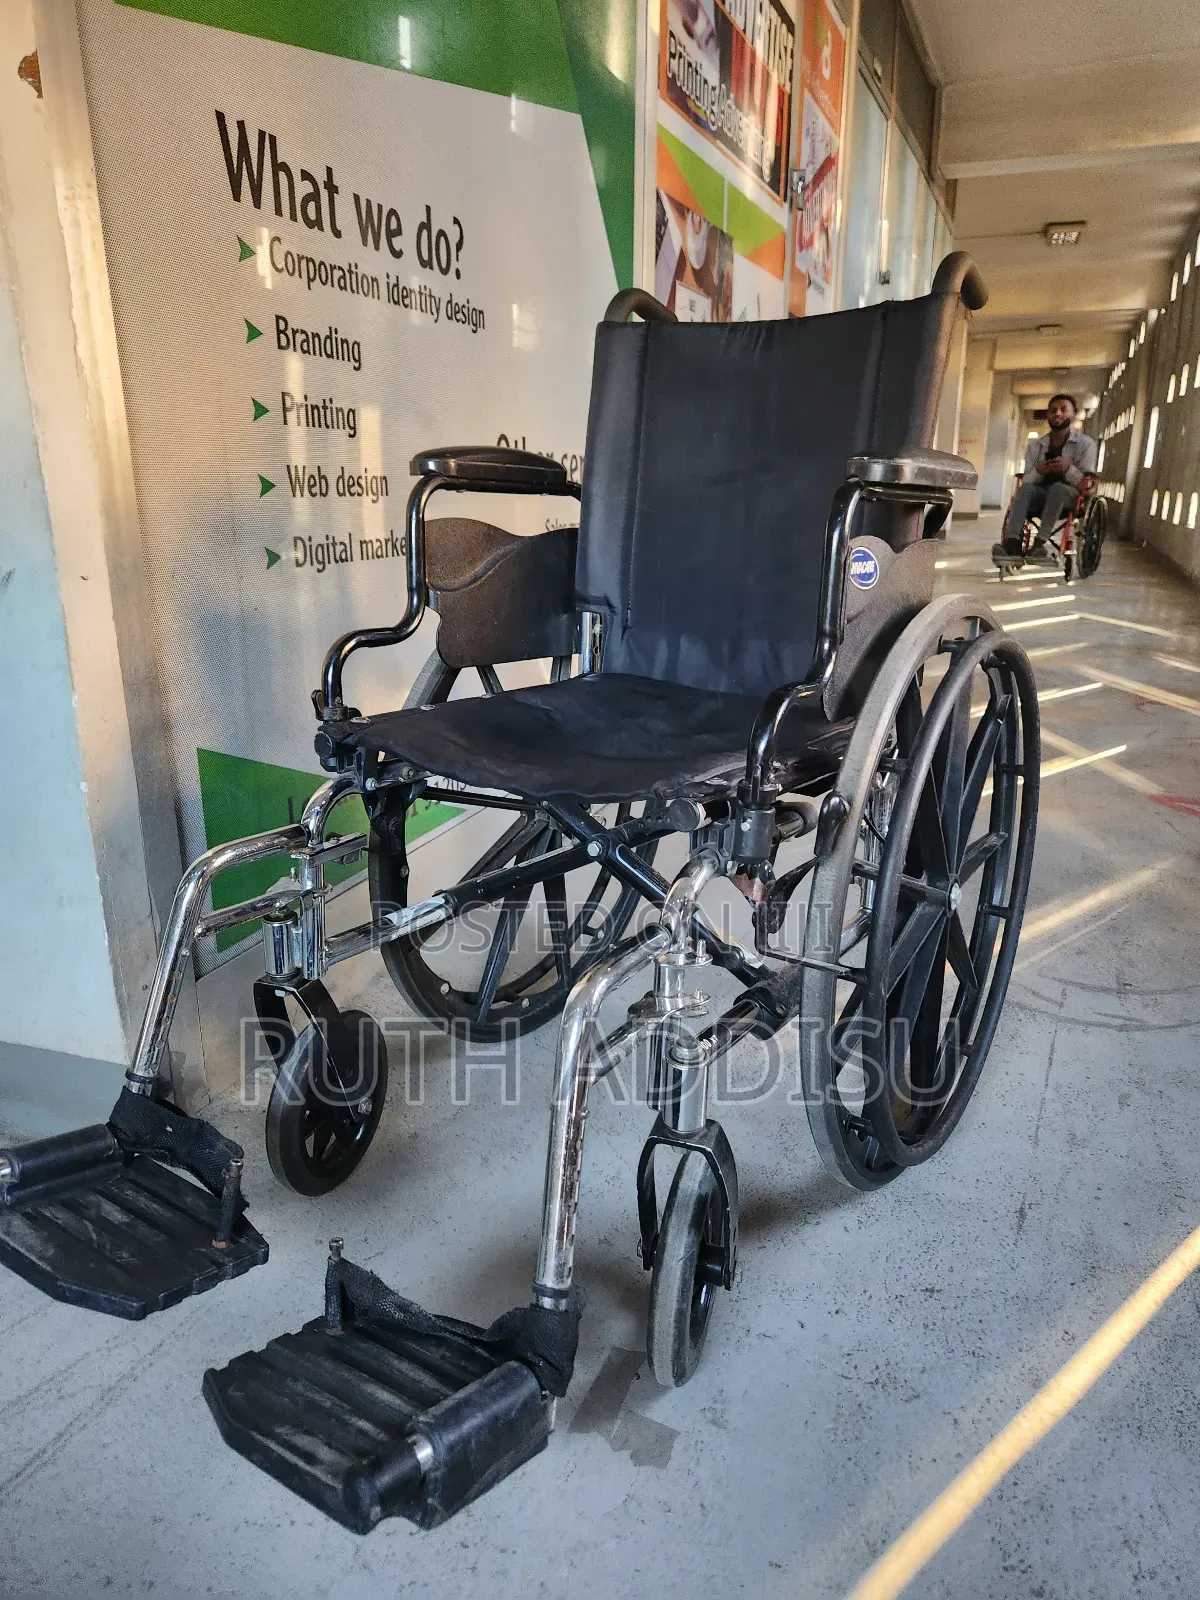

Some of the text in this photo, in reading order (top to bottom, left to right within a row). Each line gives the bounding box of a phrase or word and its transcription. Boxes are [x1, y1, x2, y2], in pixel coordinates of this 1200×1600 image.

[215, 109, 464, 280] What we do?
[268, 236, 485, 334] Corporation identity design
[275, 314, 361, 371] Branding
[281, 391, 357, 438] Printing
[286, 465, 388, 503] Web design
[293, 534, 353, 572] Digital
